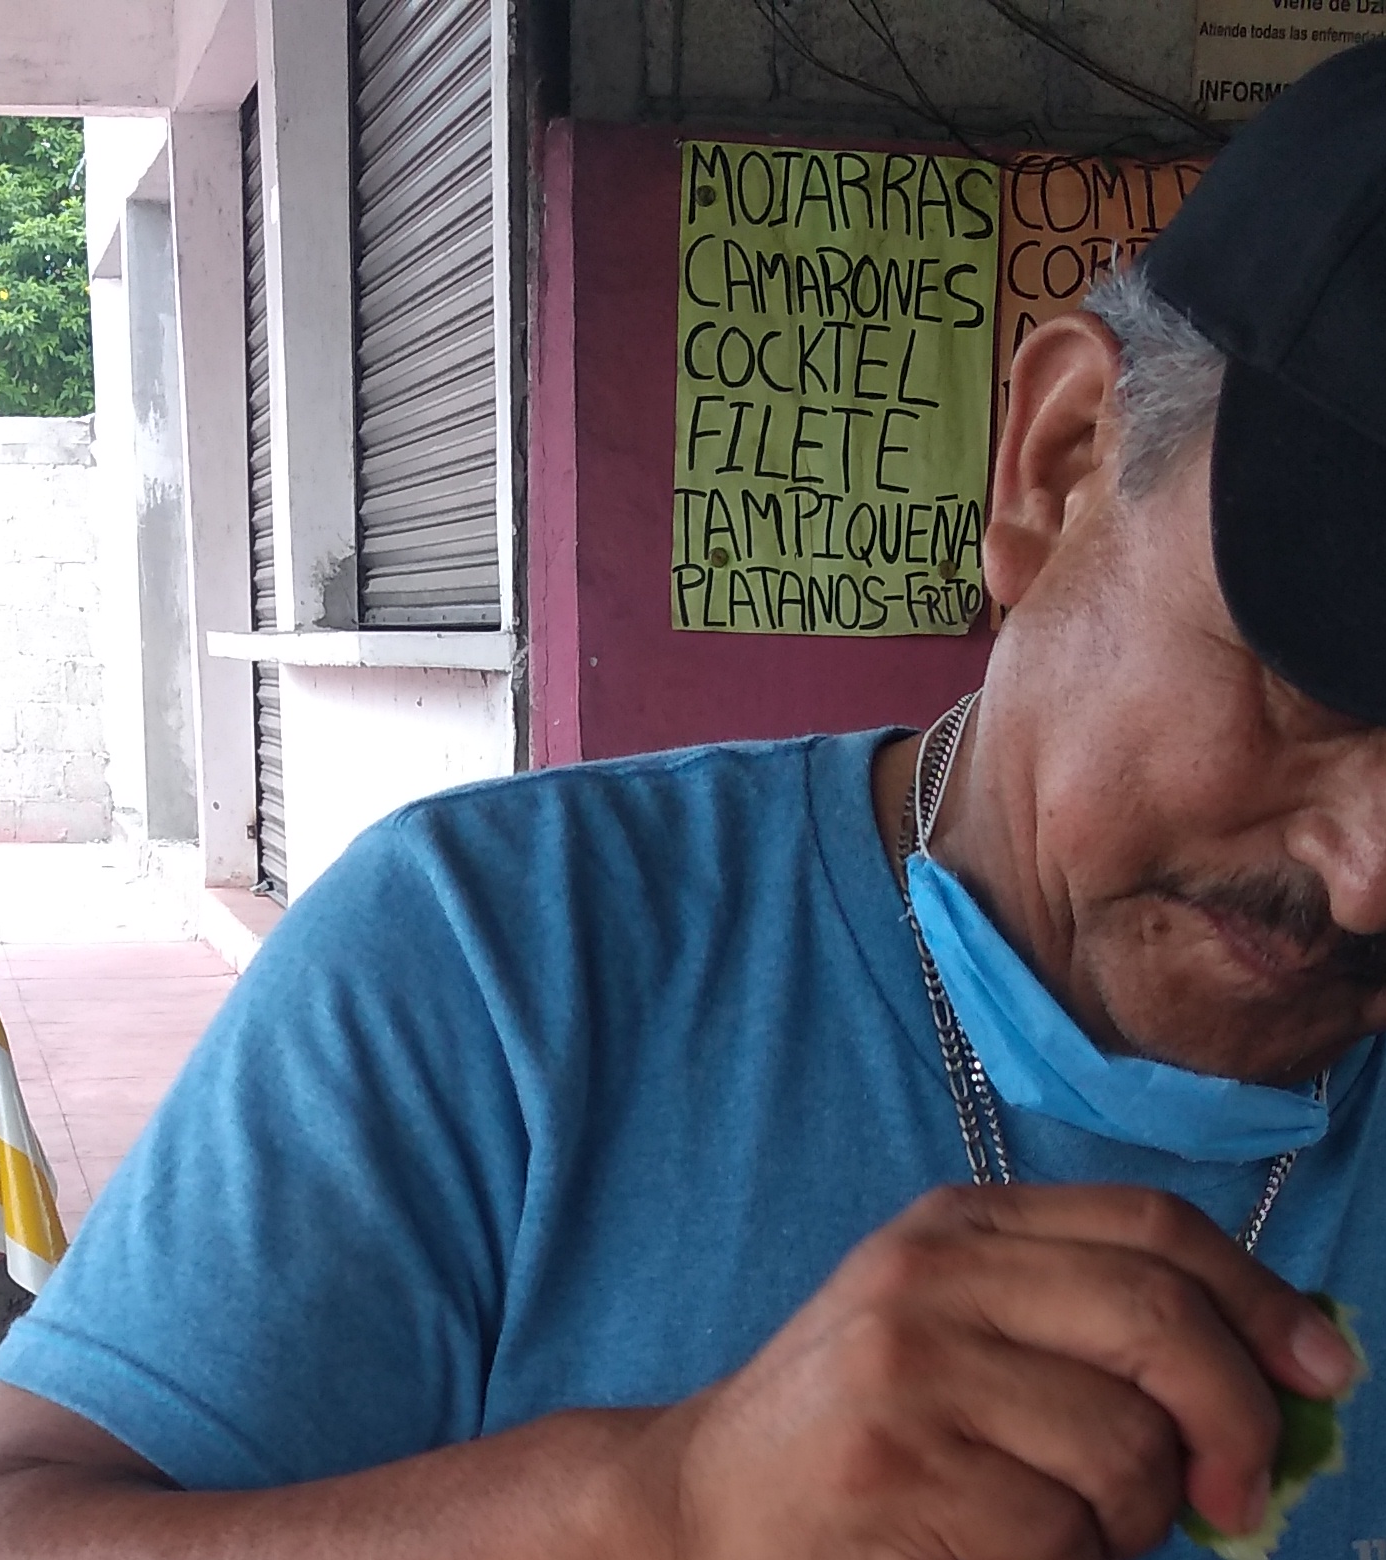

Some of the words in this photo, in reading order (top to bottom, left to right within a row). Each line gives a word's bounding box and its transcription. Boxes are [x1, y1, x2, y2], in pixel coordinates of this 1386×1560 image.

[1250, 23, 1286, 40] todas
[1289, 26, 1307, 41] las
[1199, 78, 1291, 103] INFORM
[687, 144, 994, 240] MOJARRAS
[684, 234, 985, 329] CAMARONES
[1007, 236, 1153, 300] COR
[684, 321, 940, 409] COCKTEL
[686, 395, 922, 493] FILETE
[673, 487, 983, 569] TAMPIQUEÑA
